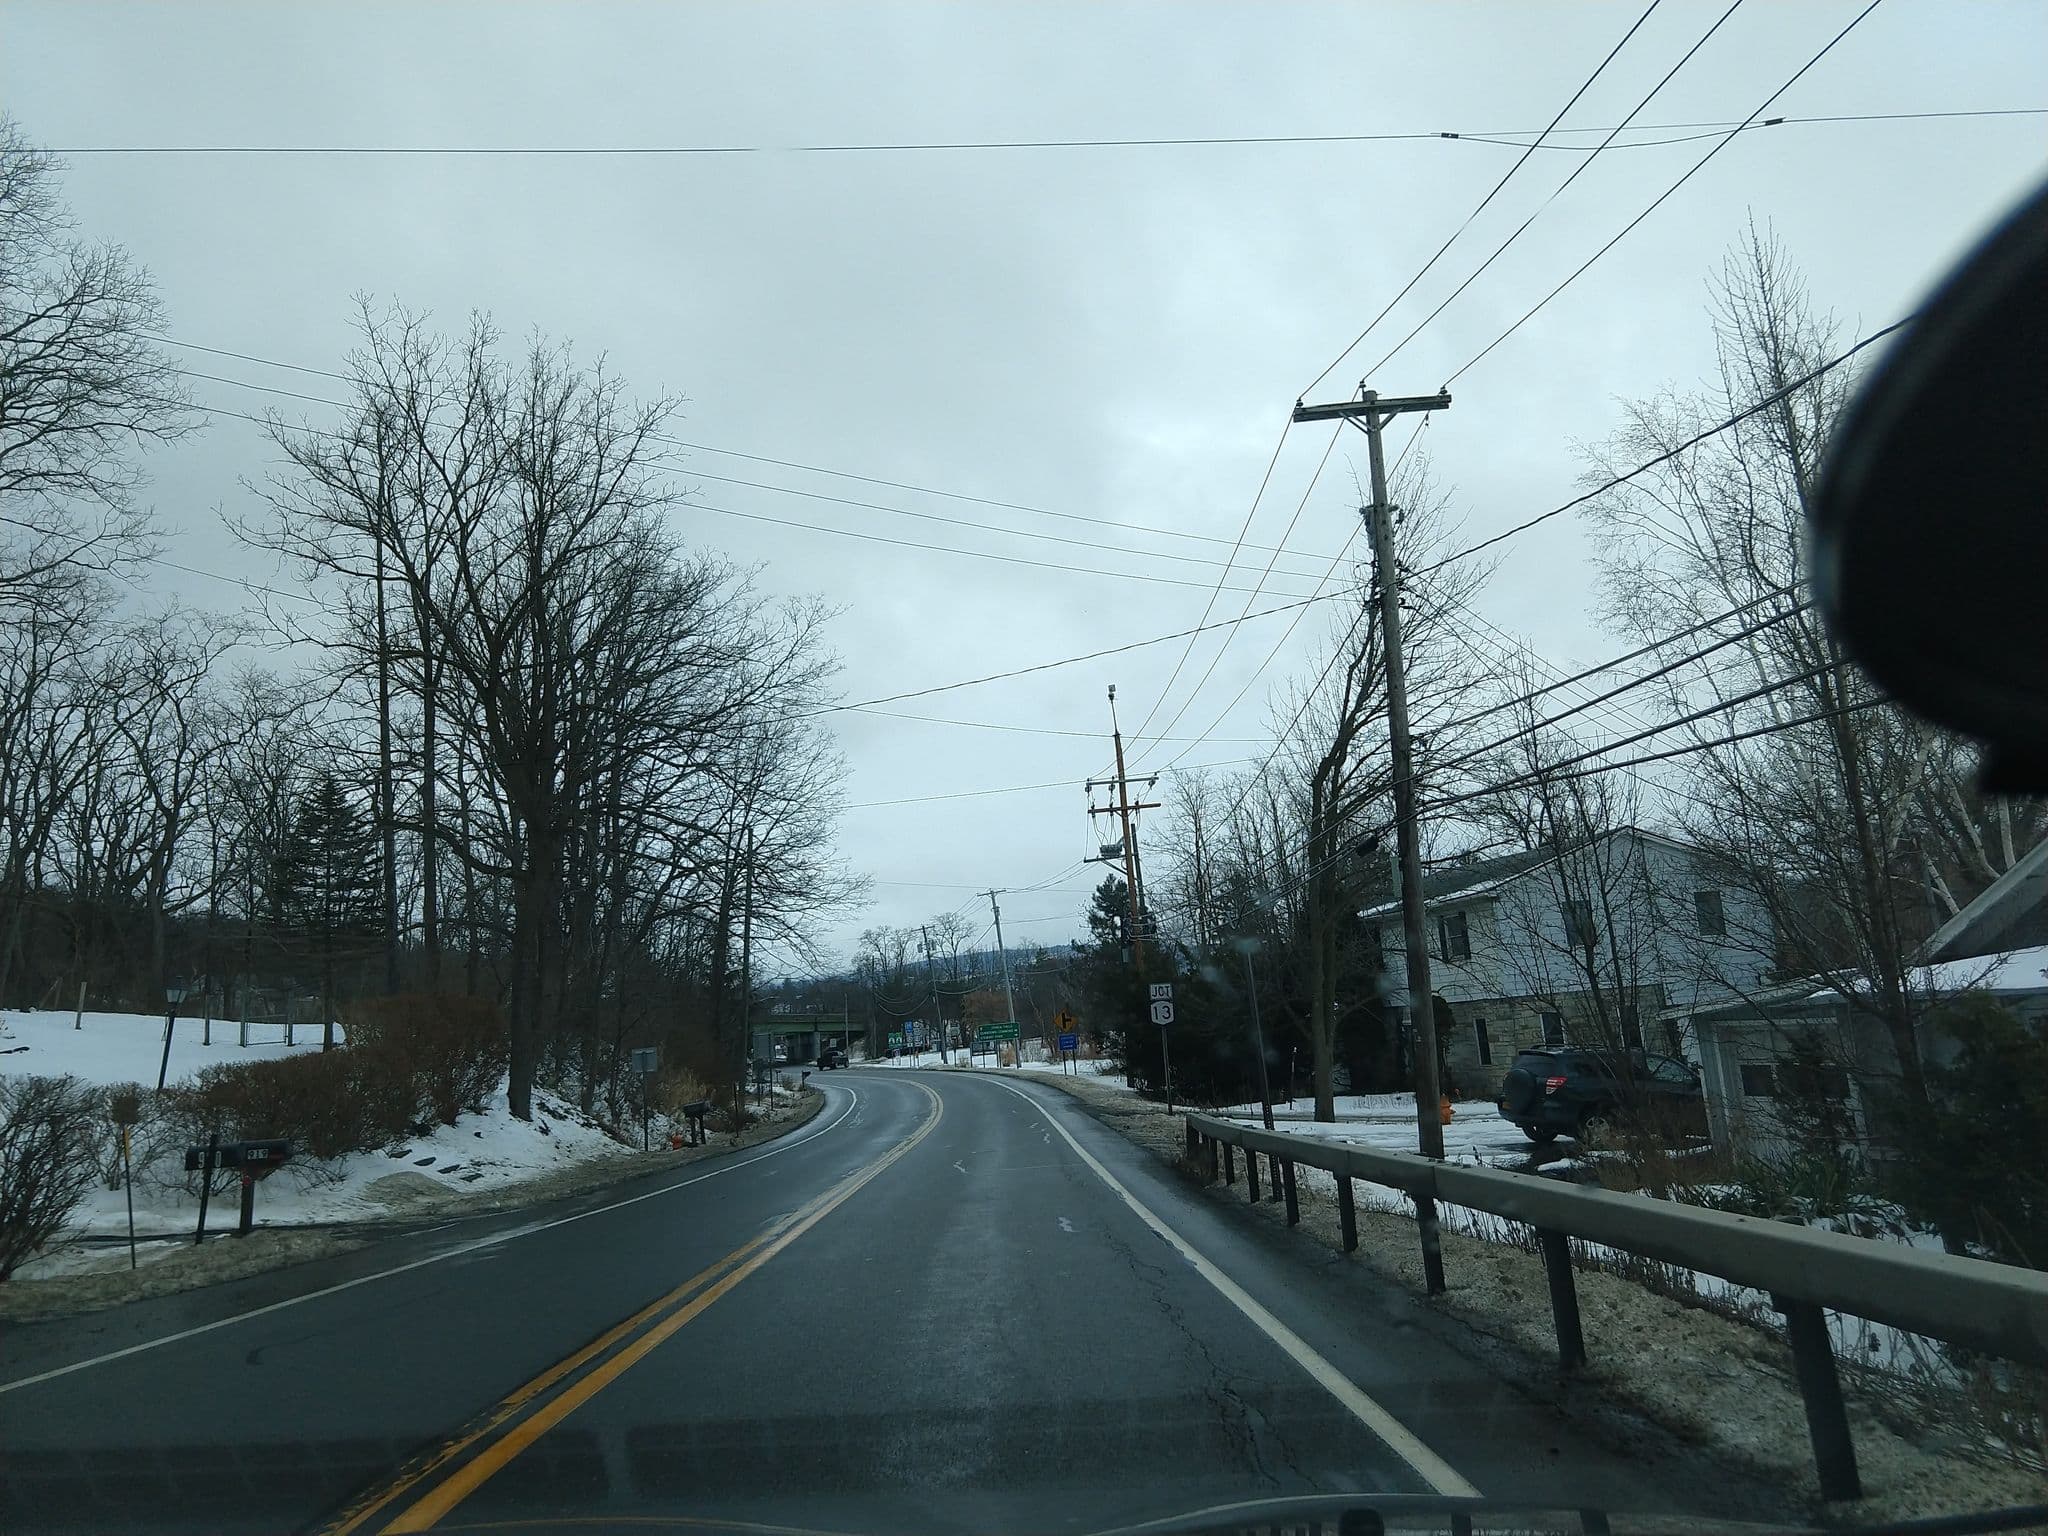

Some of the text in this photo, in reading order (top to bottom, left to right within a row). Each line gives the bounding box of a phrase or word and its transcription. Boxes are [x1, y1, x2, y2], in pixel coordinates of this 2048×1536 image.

[1152, 986, 1170, 997] JCT
[1154, 1005, 1171, 1020] 13
[198, 1150, 222, 1169] 90
